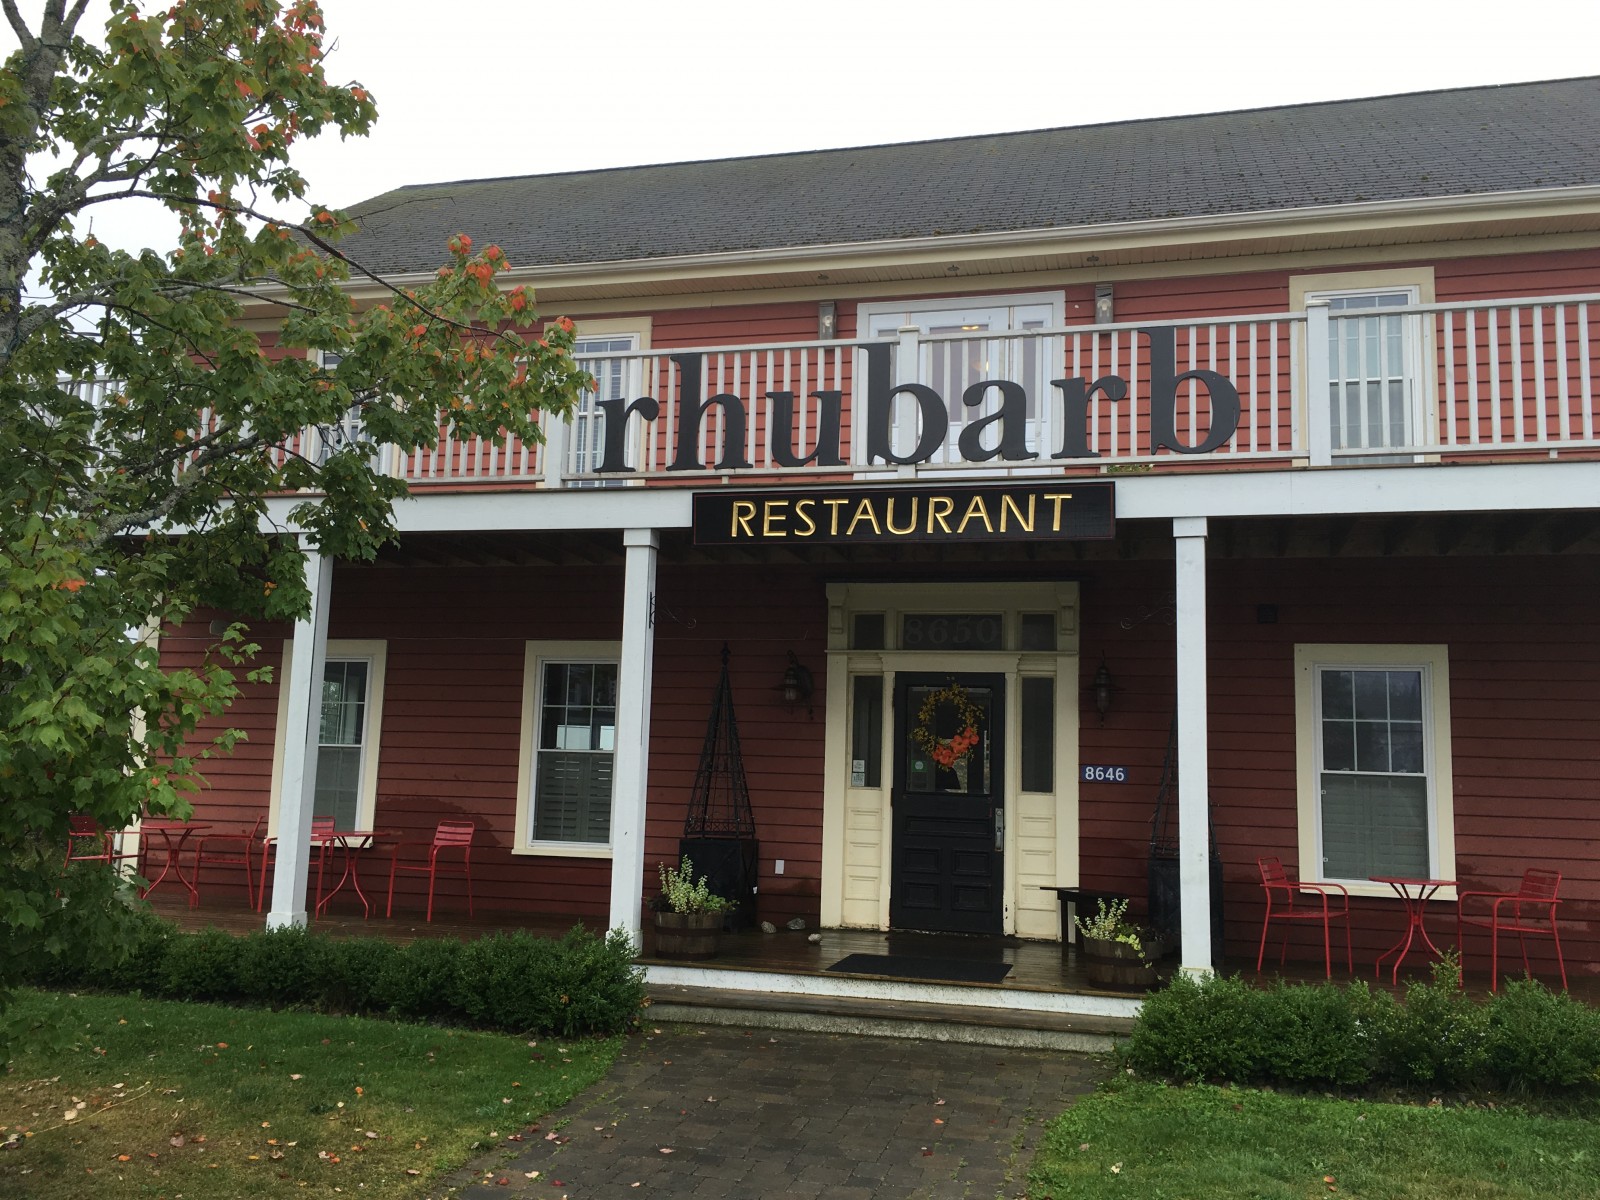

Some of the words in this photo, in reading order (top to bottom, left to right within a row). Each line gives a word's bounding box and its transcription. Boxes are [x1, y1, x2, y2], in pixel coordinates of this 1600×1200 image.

[594, 327, 1241, 472] rhubarb
[731, 493, 1072, 538] RESTAURANT
[905, 616, 998, 644] 8650
[1085, 766, 1125, 782] 8646
